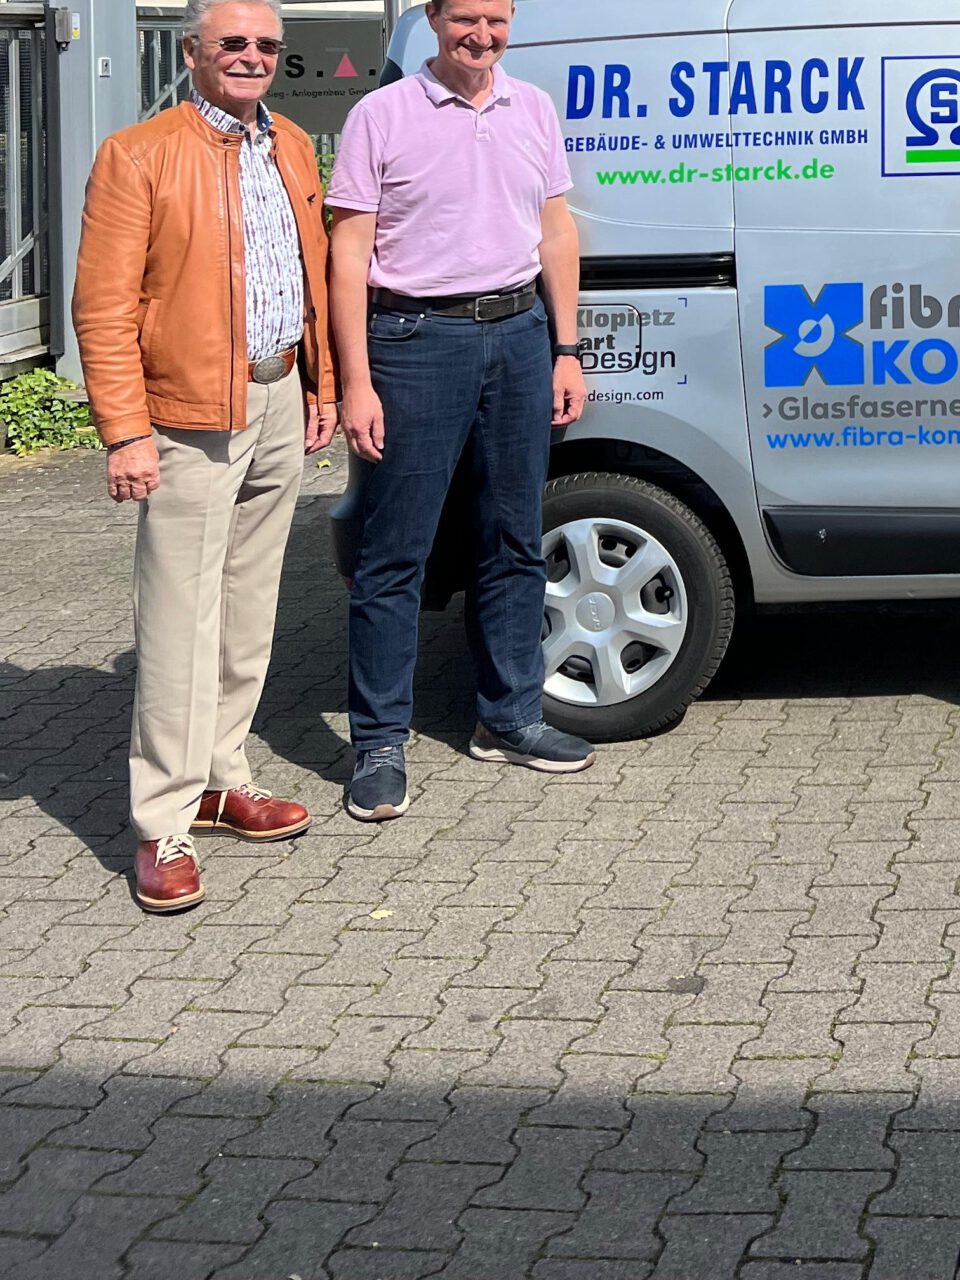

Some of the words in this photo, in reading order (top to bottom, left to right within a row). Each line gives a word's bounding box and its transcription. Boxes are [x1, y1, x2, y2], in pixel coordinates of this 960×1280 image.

[566, 64, 647, 120] DR.
[669, 57, 866, 118] STARCK
[565, 133, 648, 152] GEBÄUDE-
[654, 134, 666, 150] &
[672, 130, 814, 150] UMWELTTECHNIK
[819, 129, 868, 145] GMBH
[596, 158, 835, 186] www.dr-starck.de
[580, 334, 615, 350] art
[580, 345, 676, 375] Design
[584, 389, 664, 404] design.com
